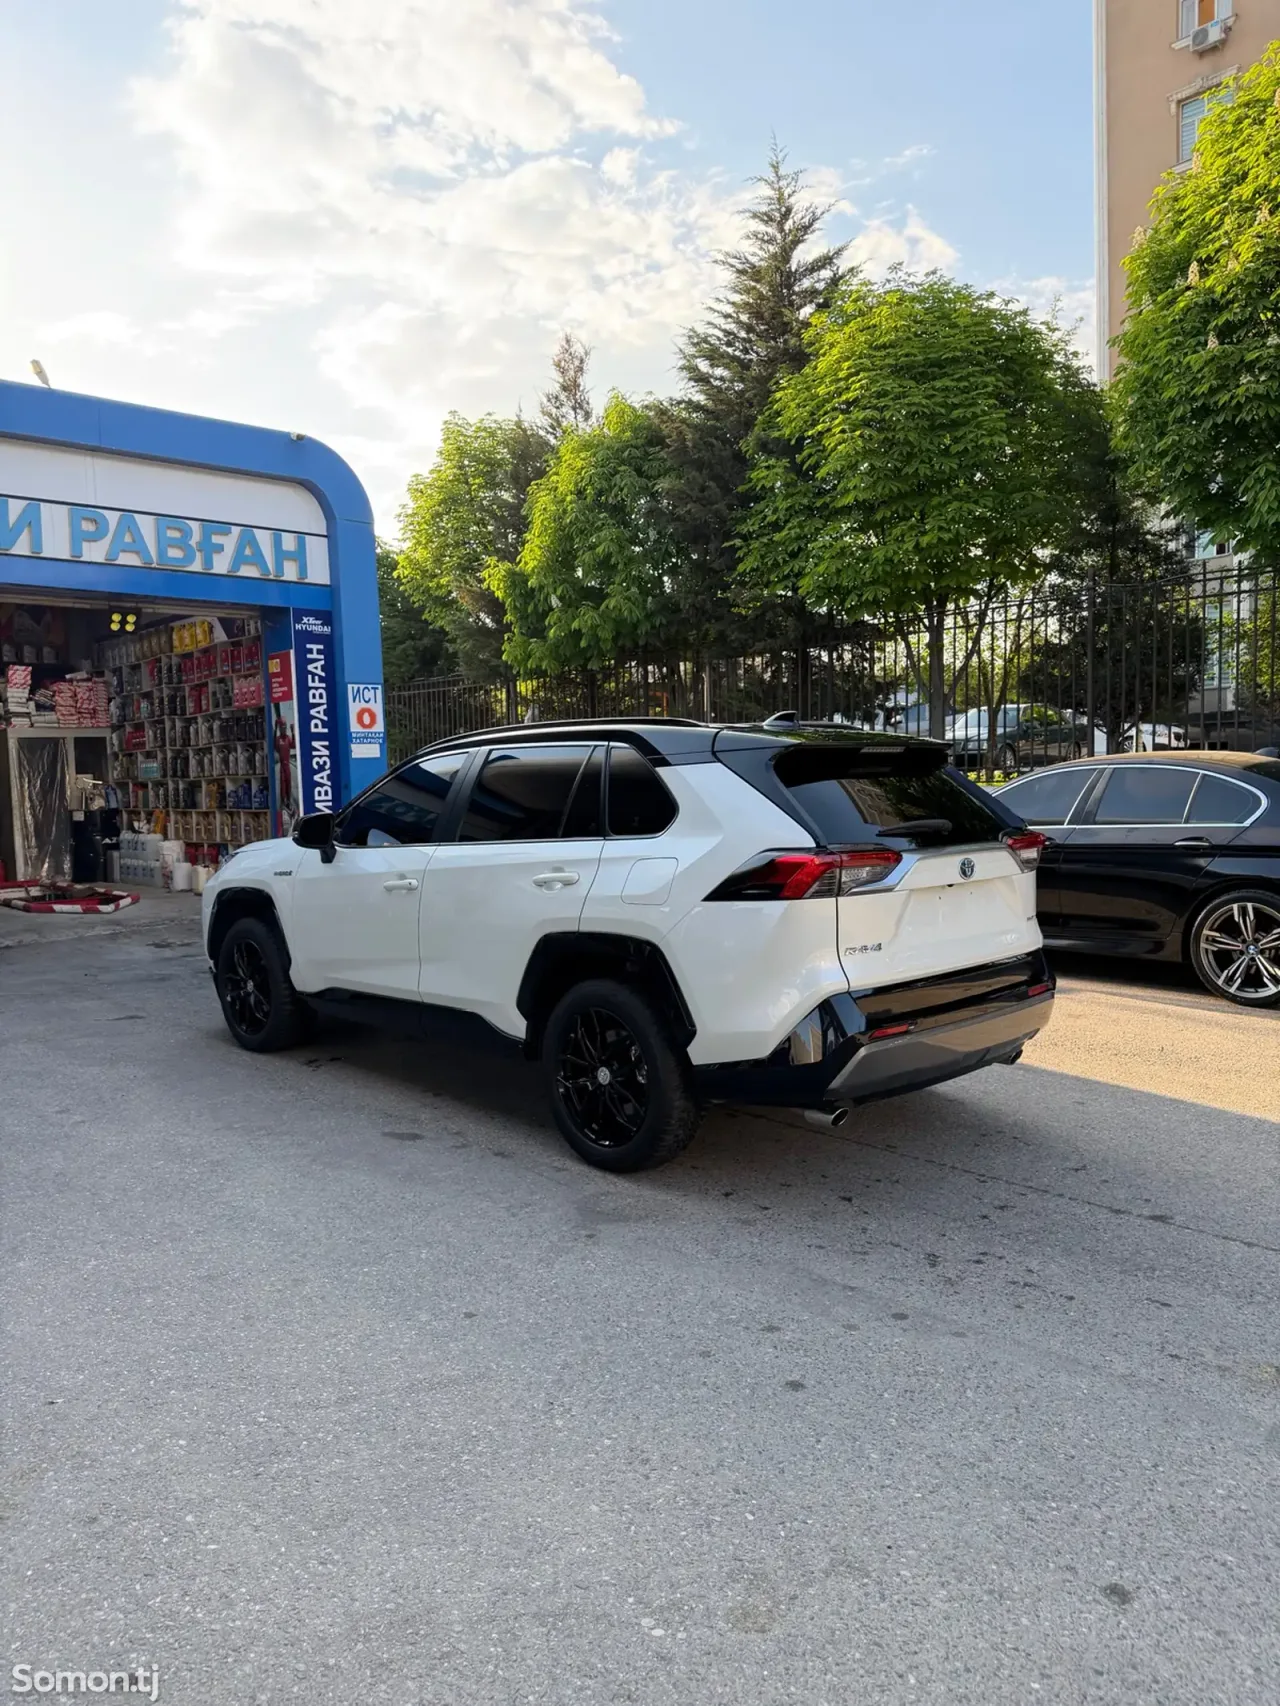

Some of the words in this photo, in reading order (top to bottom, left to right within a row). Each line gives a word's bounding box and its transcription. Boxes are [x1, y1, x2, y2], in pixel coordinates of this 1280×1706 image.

[68, 507, 309, 579] РАВҒАН
[295, 623, 331, 632] HYUNDAI
[351, 686, 379, 704] ИСТ
